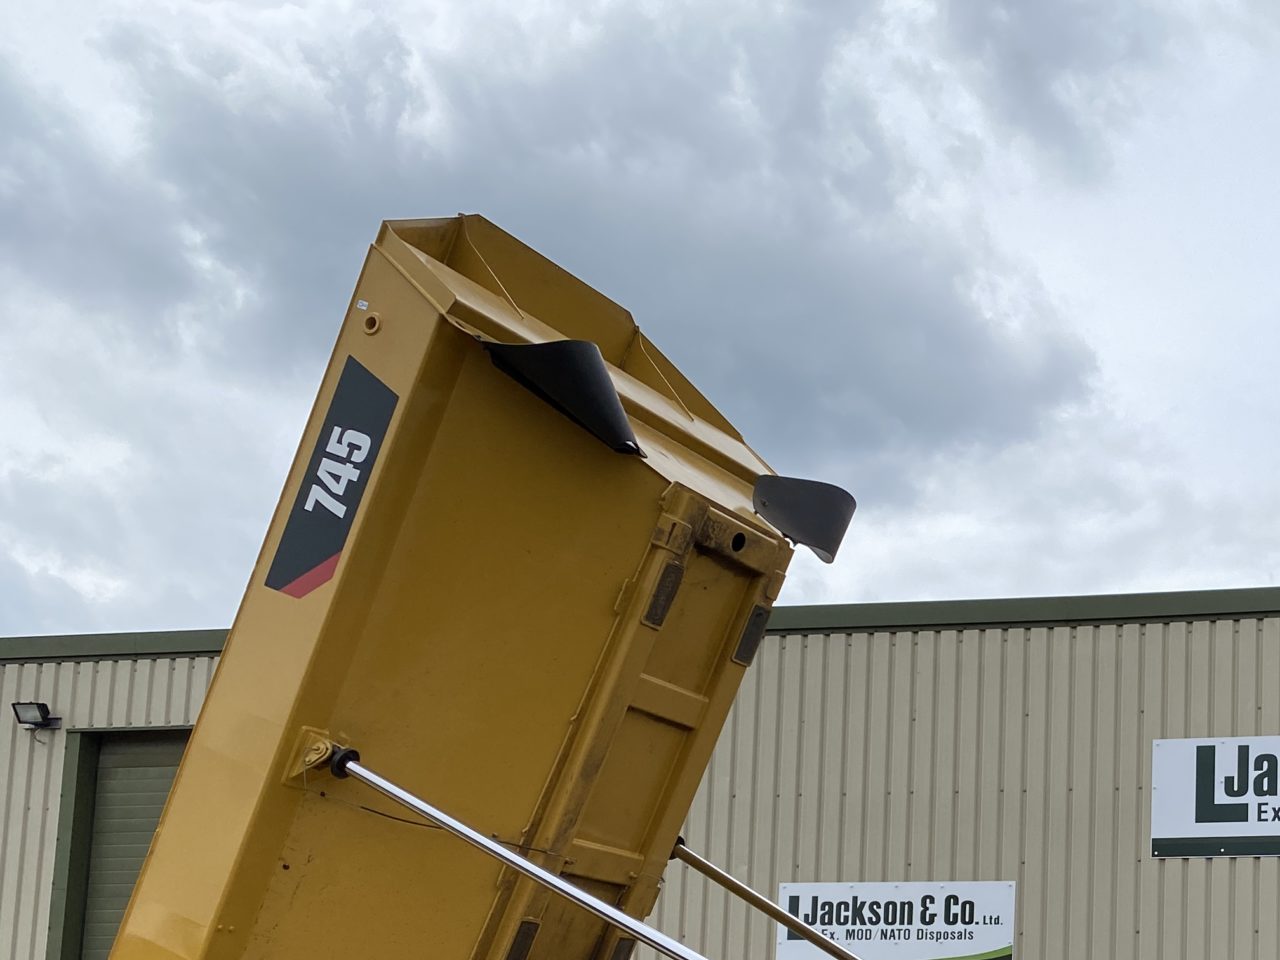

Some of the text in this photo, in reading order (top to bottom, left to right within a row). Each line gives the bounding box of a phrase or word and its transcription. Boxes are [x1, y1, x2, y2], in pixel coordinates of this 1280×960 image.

[303, 425, 372, 519] 745
[920, 894, 937, 926] &
[943, 894, 980, 926] Co.
[982, 914, 1003, 926] Ltd.
[845, 928, 911, 941] MOD/NATO
[916, 928, 974, 943] Disposals
